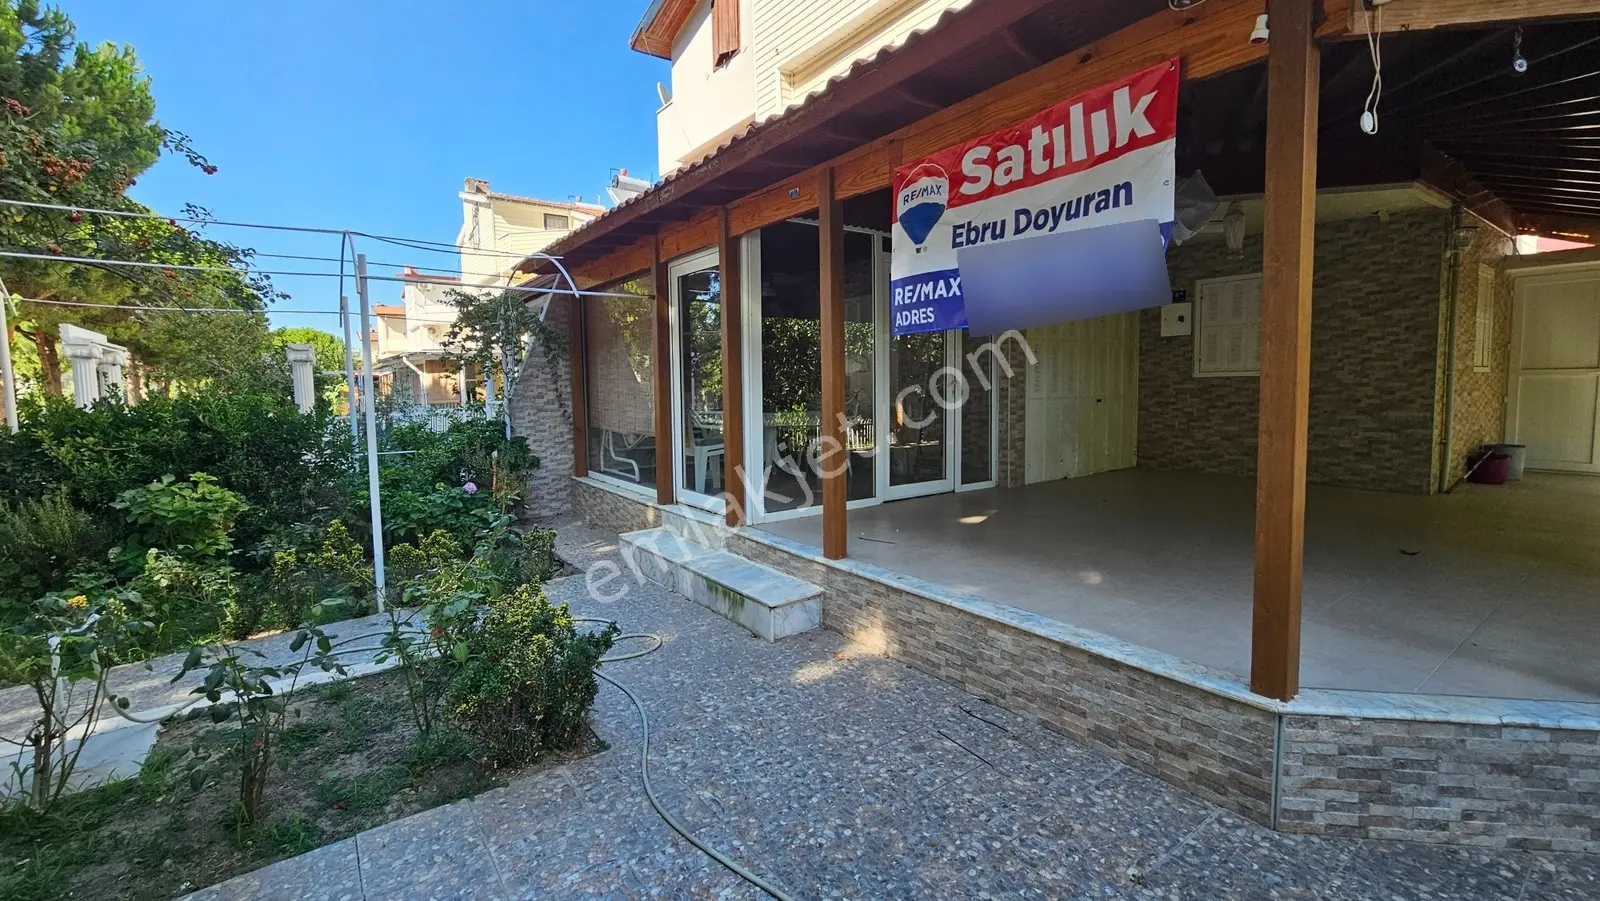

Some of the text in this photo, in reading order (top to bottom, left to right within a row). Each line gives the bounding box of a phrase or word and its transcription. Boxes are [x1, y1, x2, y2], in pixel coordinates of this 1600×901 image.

[959, 86, 1158, 195] Satılık
[903, 184, 942, 206] RE/MAX
[952, 181, 1133, 249] Ebru Doyuran
[894, 276, 961, 306] RE/MAX
[895, 307, 935, 327] ADRES
